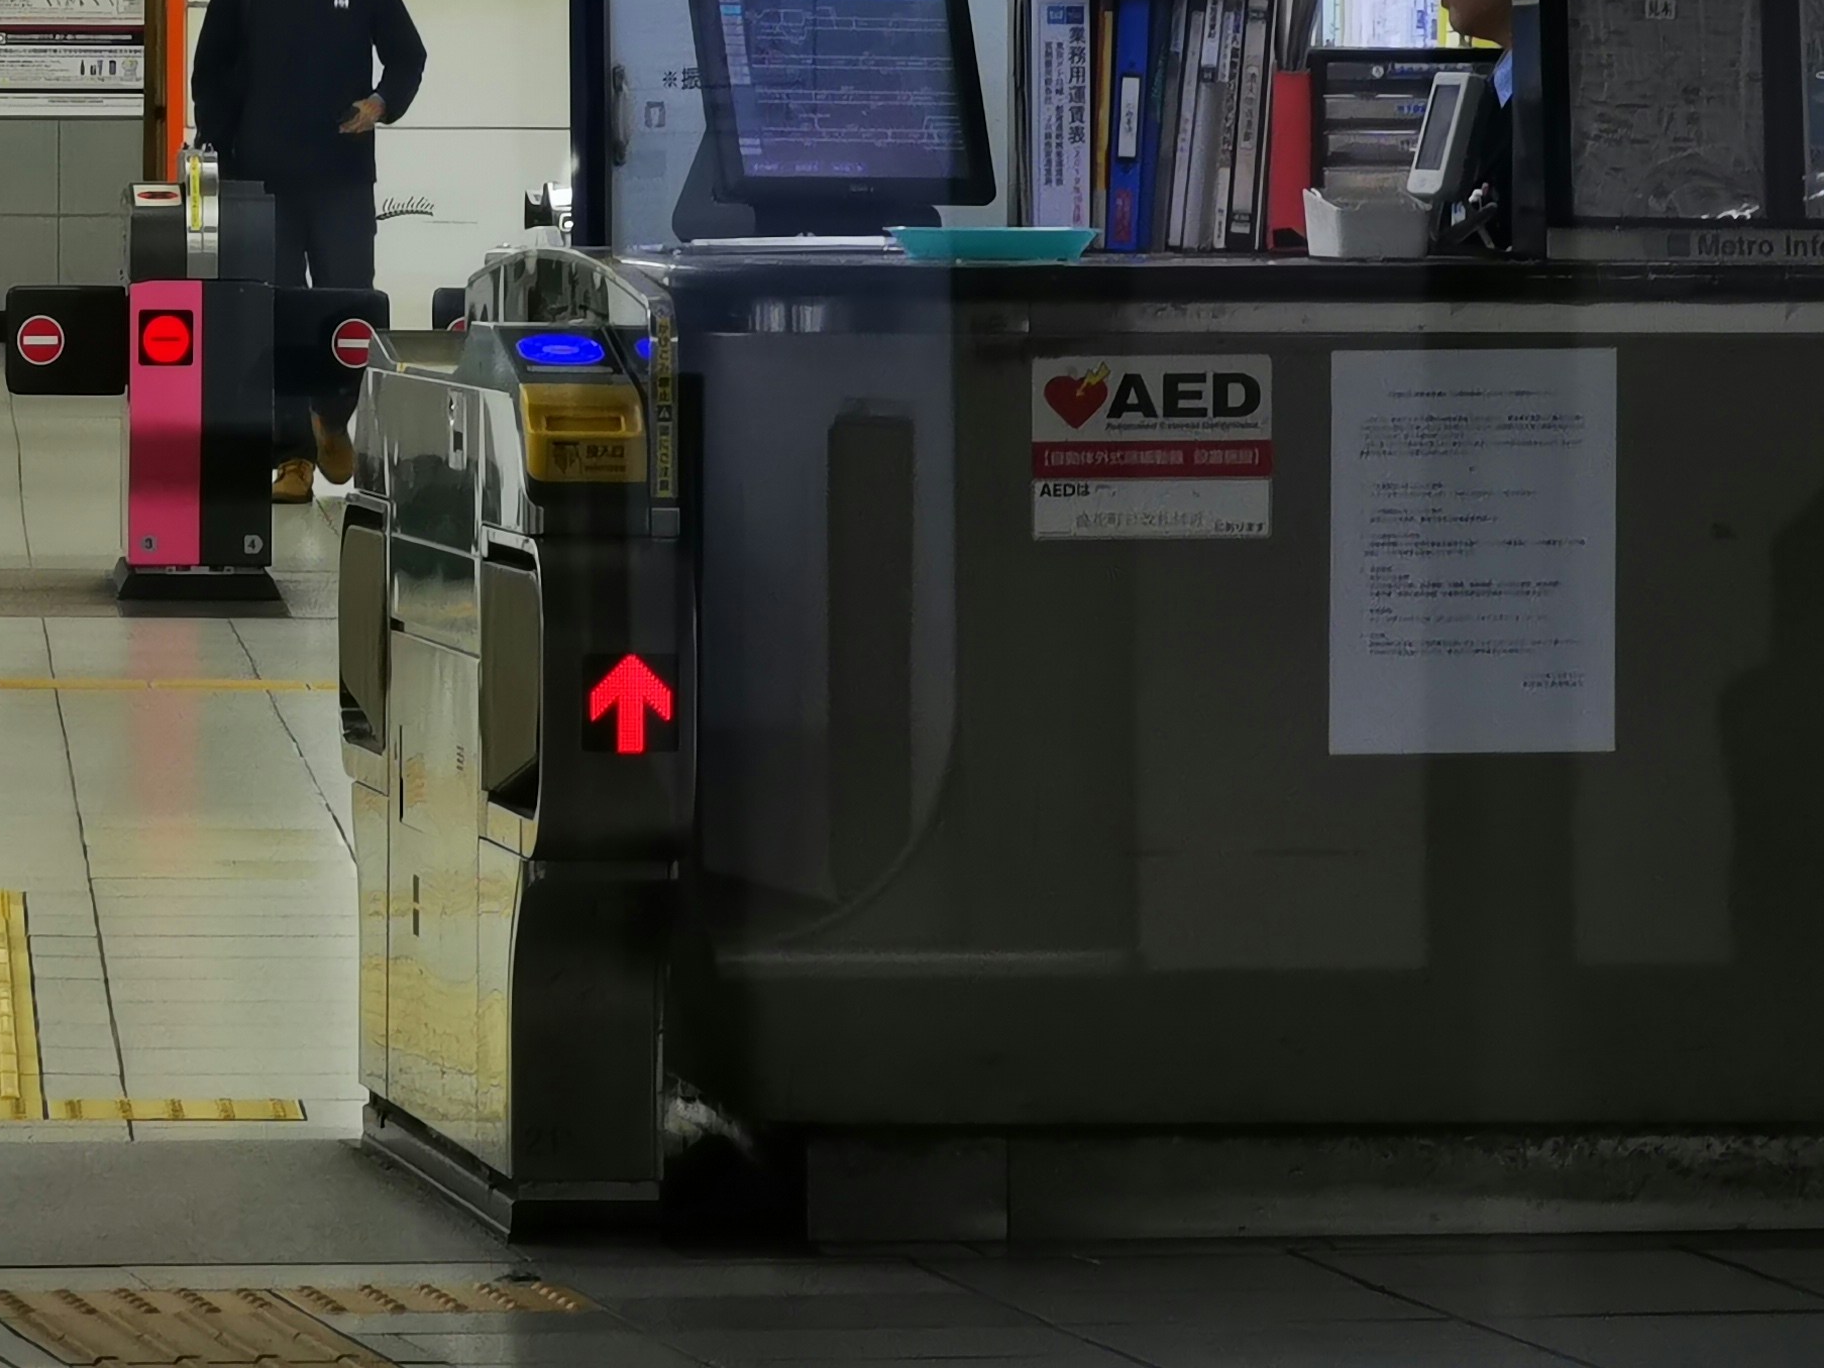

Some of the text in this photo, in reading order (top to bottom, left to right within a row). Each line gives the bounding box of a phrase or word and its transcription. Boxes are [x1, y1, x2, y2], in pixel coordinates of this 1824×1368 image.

[1697, 234, 1774, 257] Metro
[1106, 372, 1261, 418] AED
[247, 537, 259, 550] 4
